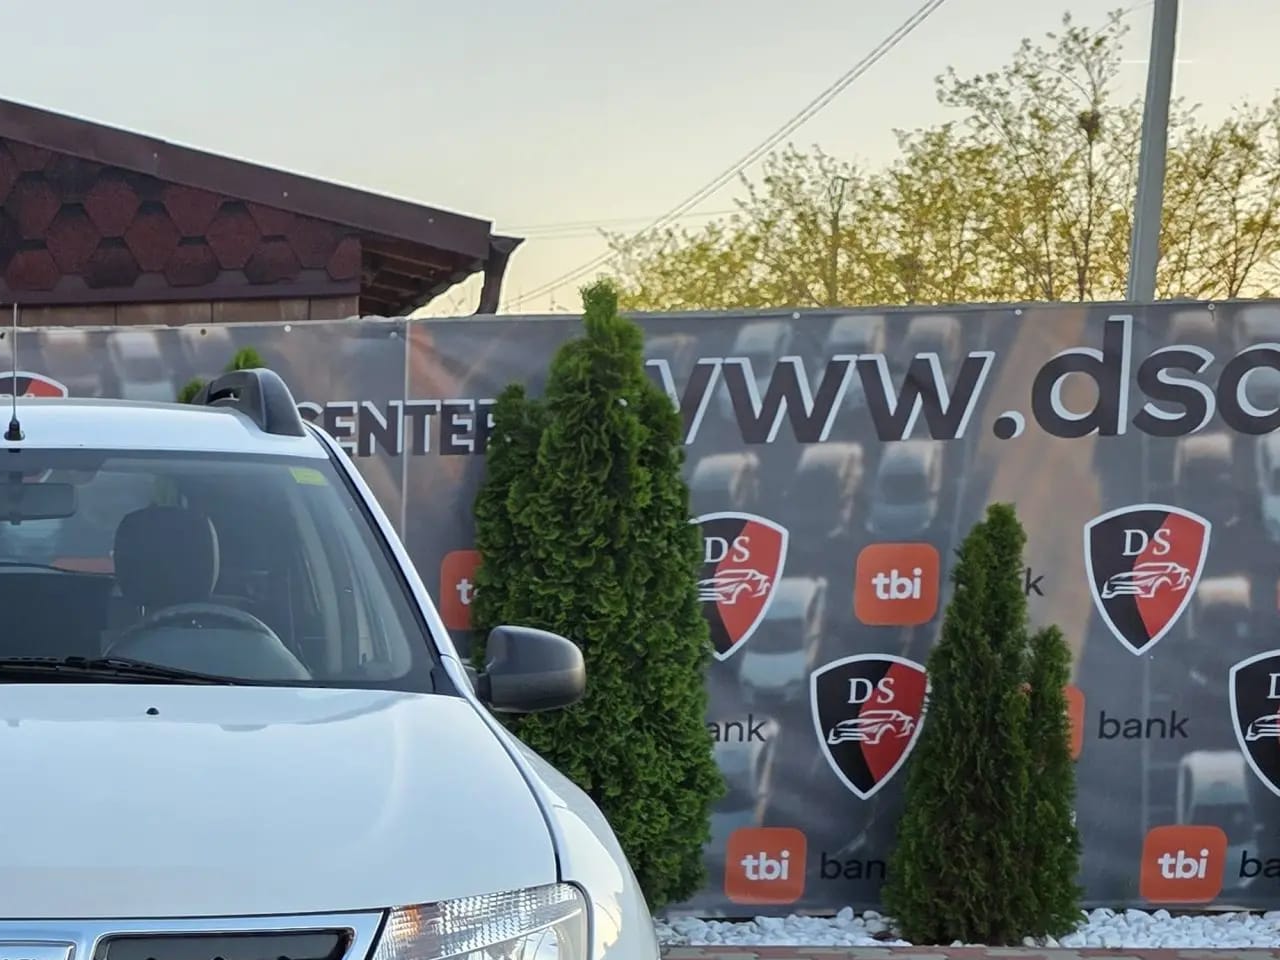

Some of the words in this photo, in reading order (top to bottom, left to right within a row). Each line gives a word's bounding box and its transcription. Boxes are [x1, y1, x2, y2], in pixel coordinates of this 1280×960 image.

[704, 536, 750, 563] DS
[1123, 528, 1171, 556] DS
[872, 568, 922, 600] tbi
[848, 678, 894, 704] DS
[1098, 711, 1189, 740] bank
[741, 850, 790, 880] tbi
[821, 852, 887, 879] ban
[1158, 849, 1209, 879] tbi
